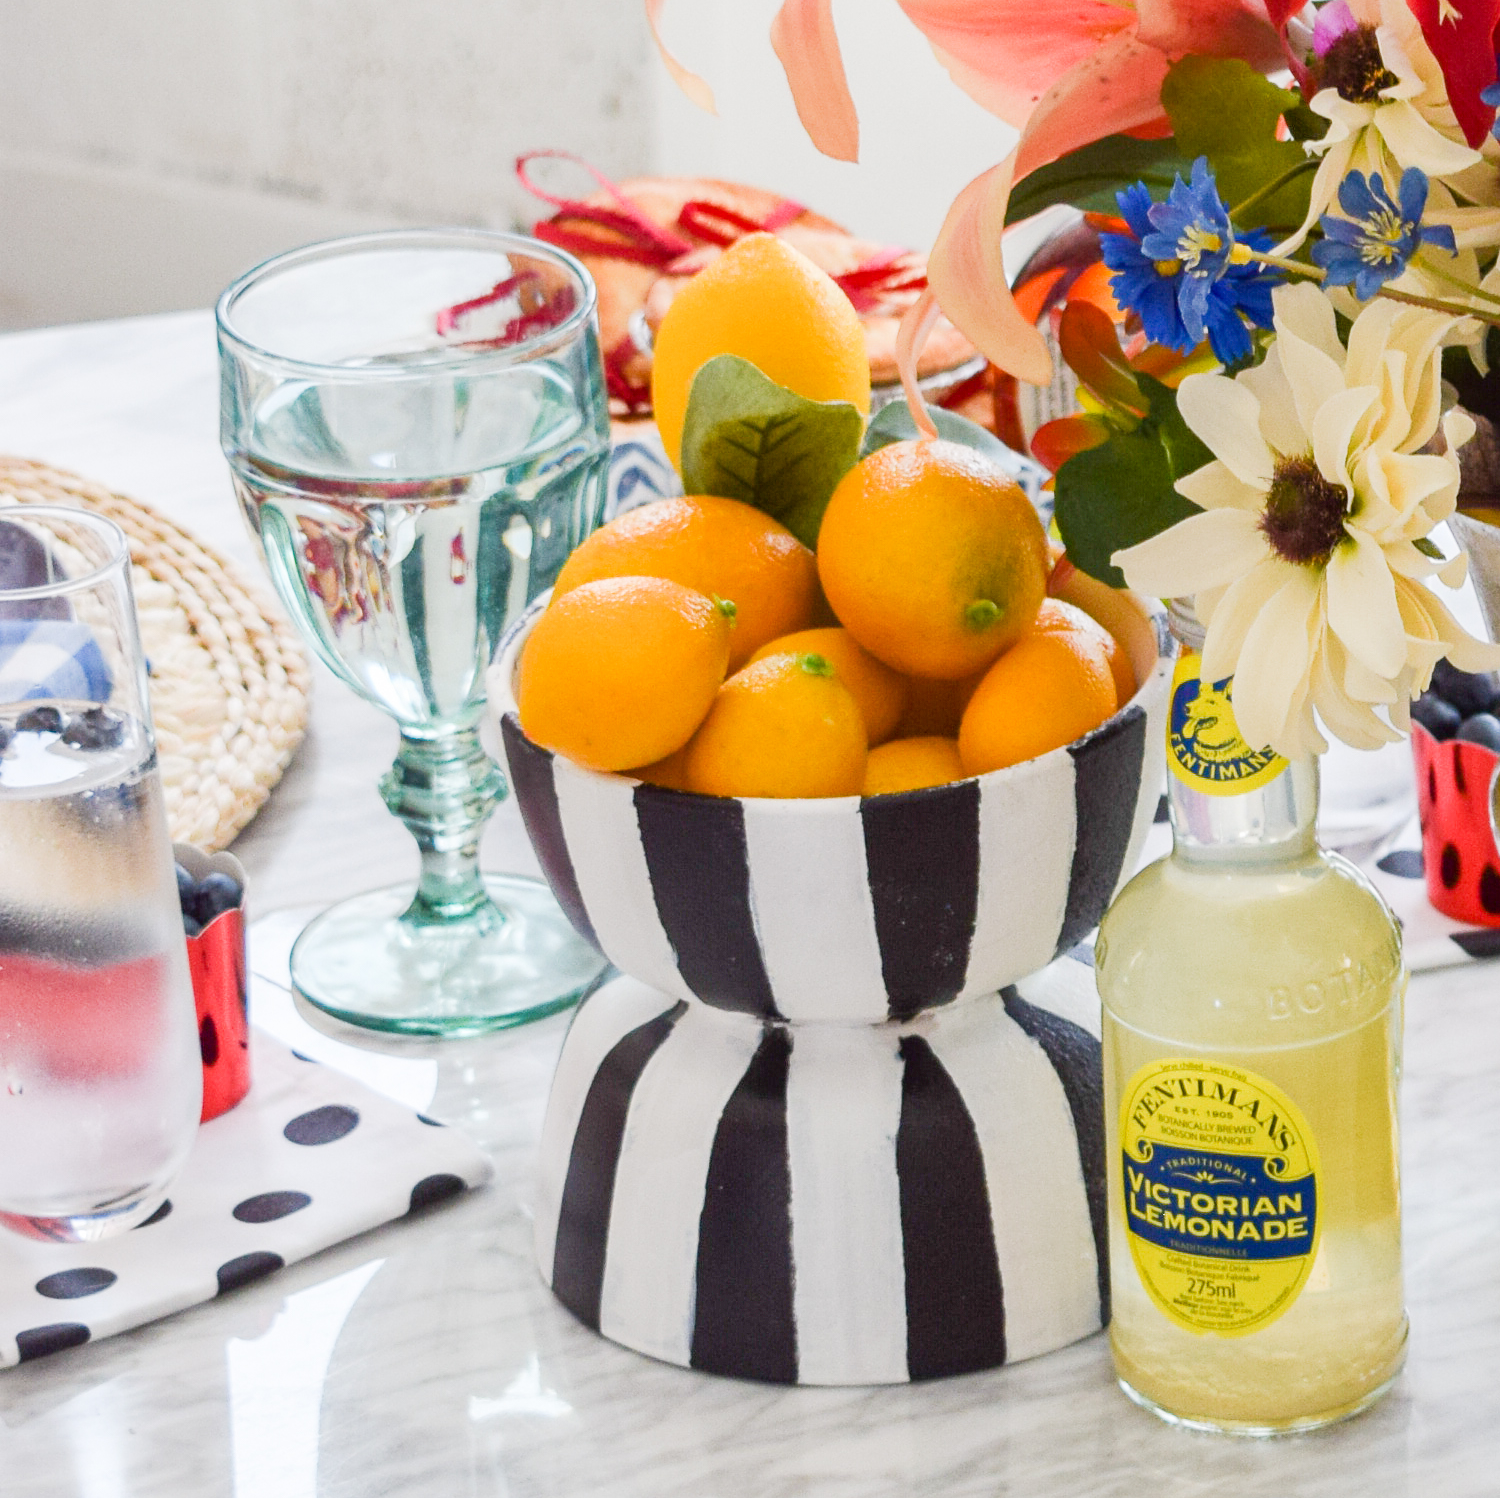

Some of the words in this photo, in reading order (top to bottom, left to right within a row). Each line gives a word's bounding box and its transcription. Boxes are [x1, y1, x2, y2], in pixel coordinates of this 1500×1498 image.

[1132, 1077, 1296, 1152] FENTIMANS
[1174, 1105, 1200, 1116] EST.
[1206, 1109, 1234, 1120] 1905
[1158, 1113, 1215, 1133] BOTANICALLY
[1216, 1123, 1257, 1135] BREWED
[1161, 1125, 1198, 1141] BOISSON
[1199, 1132, 1254, 1146] BOTANIQUE
[1166, 1156, 1248, 1181] TRADITIONAL
[1127, 1166, 1303, 1218] VICTORIAN
[1129, 1191, 1309, 1242] LEMONADE
[1169, 1238, 1249, 1258] TRADITIONNELLE
[1187, 1277, 1236, 1299] 275ml
